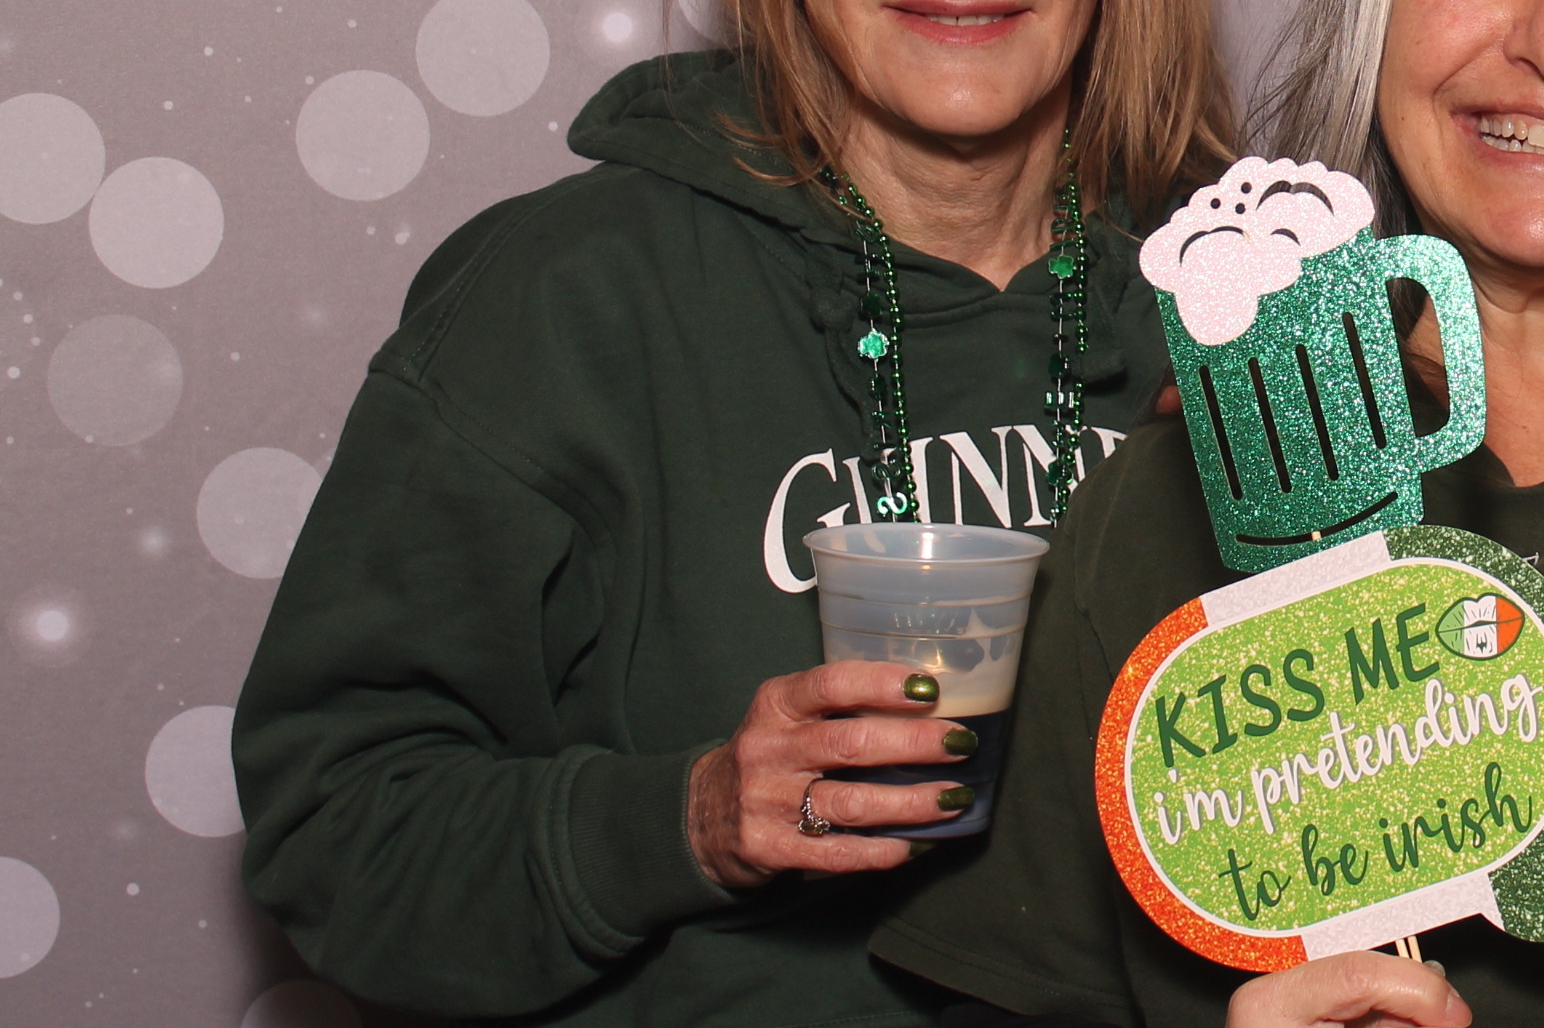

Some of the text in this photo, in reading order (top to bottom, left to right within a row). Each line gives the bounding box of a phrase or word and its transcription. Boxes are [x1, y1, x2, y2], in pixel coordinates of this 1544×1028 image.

[1154, 603, 1440, 767] KISS ME
[1250, 673, 1543, 834] pretending
[1218, 761, 1533, 921] to be irish
